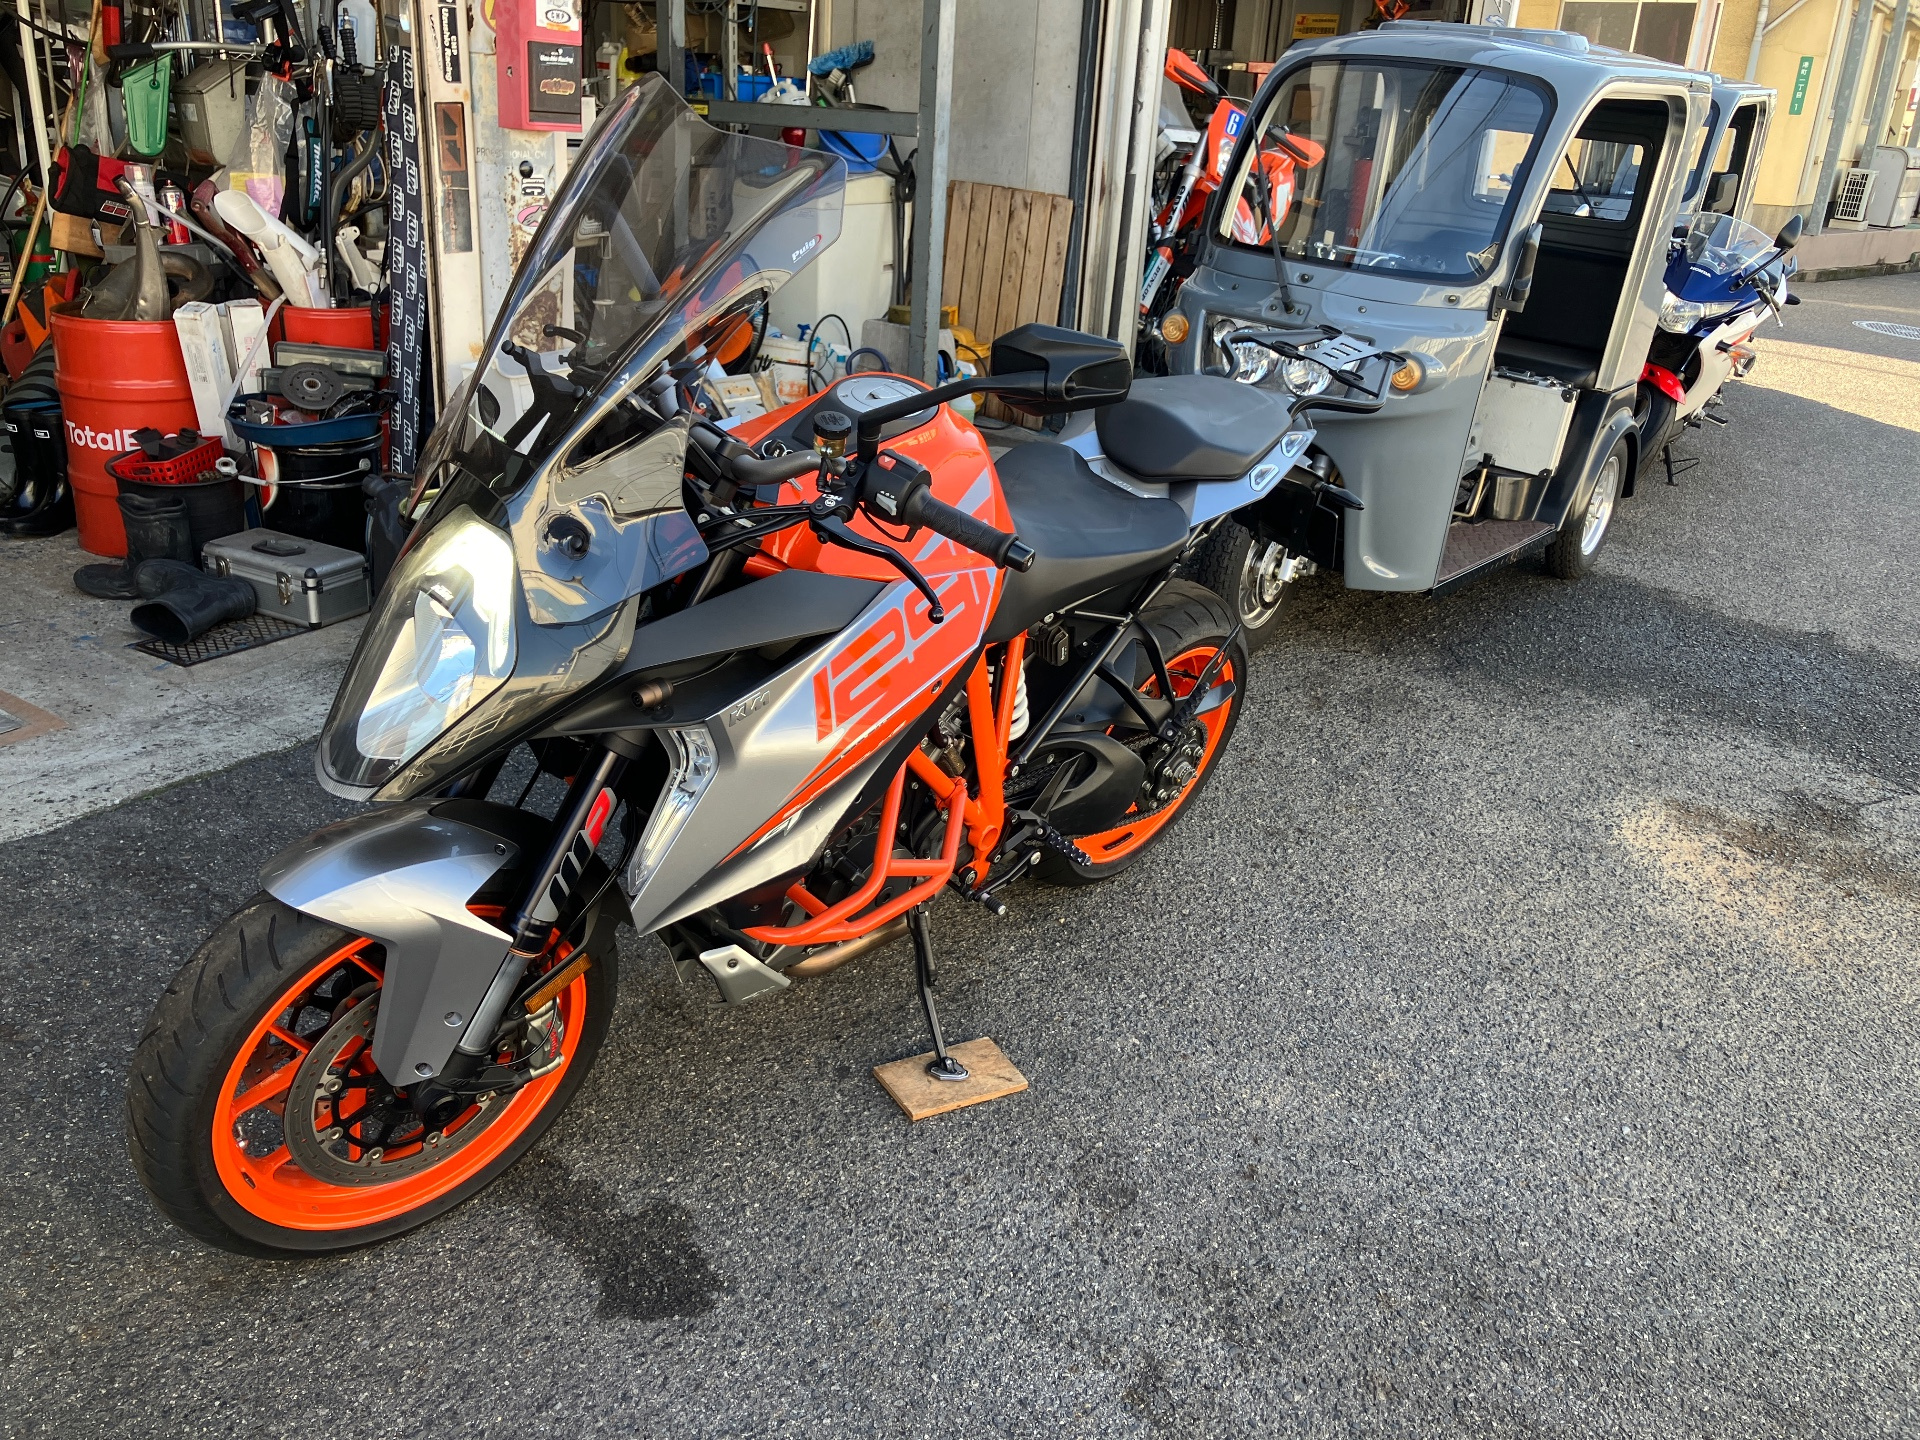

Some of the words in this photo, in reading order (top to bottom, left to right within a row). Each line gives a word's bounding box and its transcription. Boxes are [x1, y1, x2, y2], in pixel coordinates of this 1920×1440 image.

[403, 103, 416, 142] KTM
[1226, 112, 1240, 135] 6
[390, 131, 403, 168] KTM
[406, 157, 418, 195] KTM
[393, 184, 404, 221] KTM
[407, 210, 418, 248] KTM
[393, 237, 404, 274] KTM
[791, 238, 816, 262] Puig
[407, 263, 417, 300] KTM
[392, 289, 403, 326] KTM
[405, 314, 415, 353] KTM
[391, 342, 401, 378] KTM
[404, 367, 413, 404] KTM
[404, 419, 412, 456] KTM
[729, 688, 771, 728] KTM
